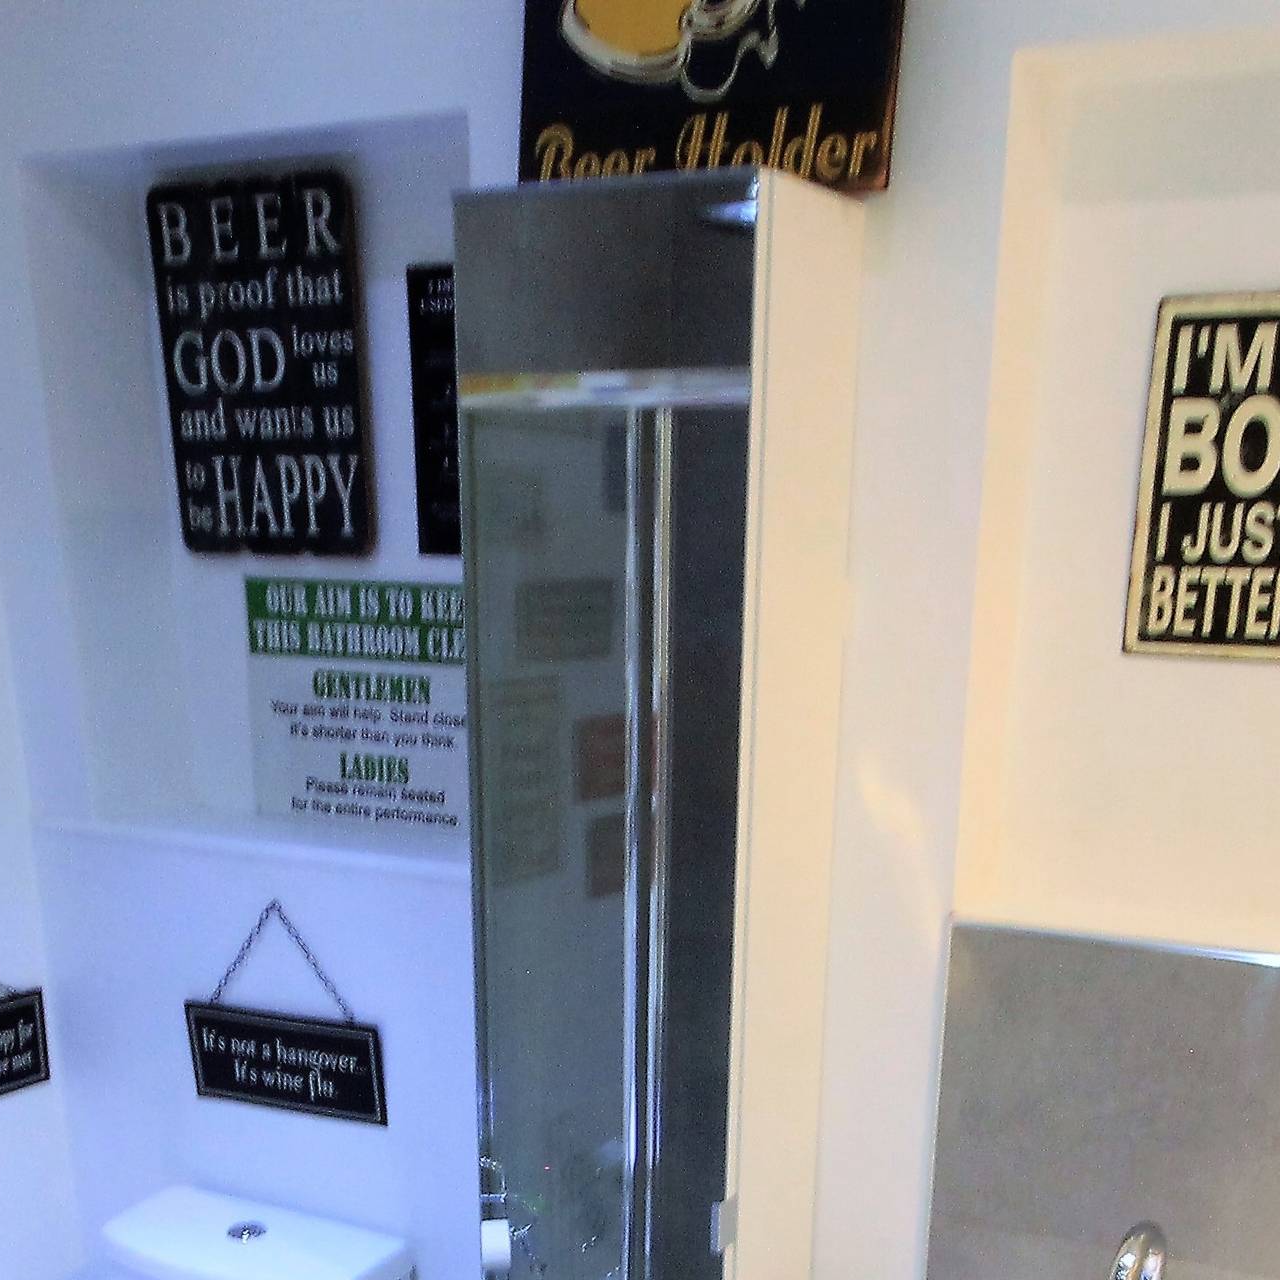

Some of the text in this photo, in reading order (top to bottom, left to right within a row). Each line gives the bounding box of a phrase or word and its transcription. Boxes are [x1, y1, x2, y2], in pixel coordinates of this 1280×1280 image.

[535, 102, 877, 183] Beer Holder
[158, 188, 340, 265] BEER
[167, 265, 345, 321] is proof that
[292, 324, 355, 358] loves
[1172, 321, 1280, 395] I'M
[174, 327, 286, 396] GOD
[312, 362, 339, 388] us
[180, 398, 356, 440] and wants us
[186, 460, 206, 490] to
[211, 454, 358, 537] HAPPY
[188, 498, 213, 532] be
[1155, 501, 1171, 562] I
[267, 584, 308, 619] OUR
[314, 585, 352, 620] AIM
[359, 585, 380, 621] IS
[386, 587, 413, 622] TO
[254, 620, 301, 650] THIS
[308, 621, 420, 658] BATHROOM
[313, 669, 431, 703] GENTLEMEN
[271, 701, 298, 714] Your
[329, 704, 349, 718] will
[390, 709, 428, 725] Stand
[312, 726, 357, 740] shorter
[360, 727, 389, 743] than
[394, 733, 416, 747] you
[339, 751, 409, 784] LADIES
[305, 775, 445, 804] Please remain seated
[292, 797, 307, 810] for
[311, 799, 331, 812] the
[335, 801, 371, 817] entire
[18, 1019, 34, 1048] for
[202, 1025, 225, 1051] It's
[232, 1038, 256, 1057] not
[262, 1043, 271, 1058] a
[234, 1058, 257, 1084] It's
[262, 1066, 304, 1090] wine
